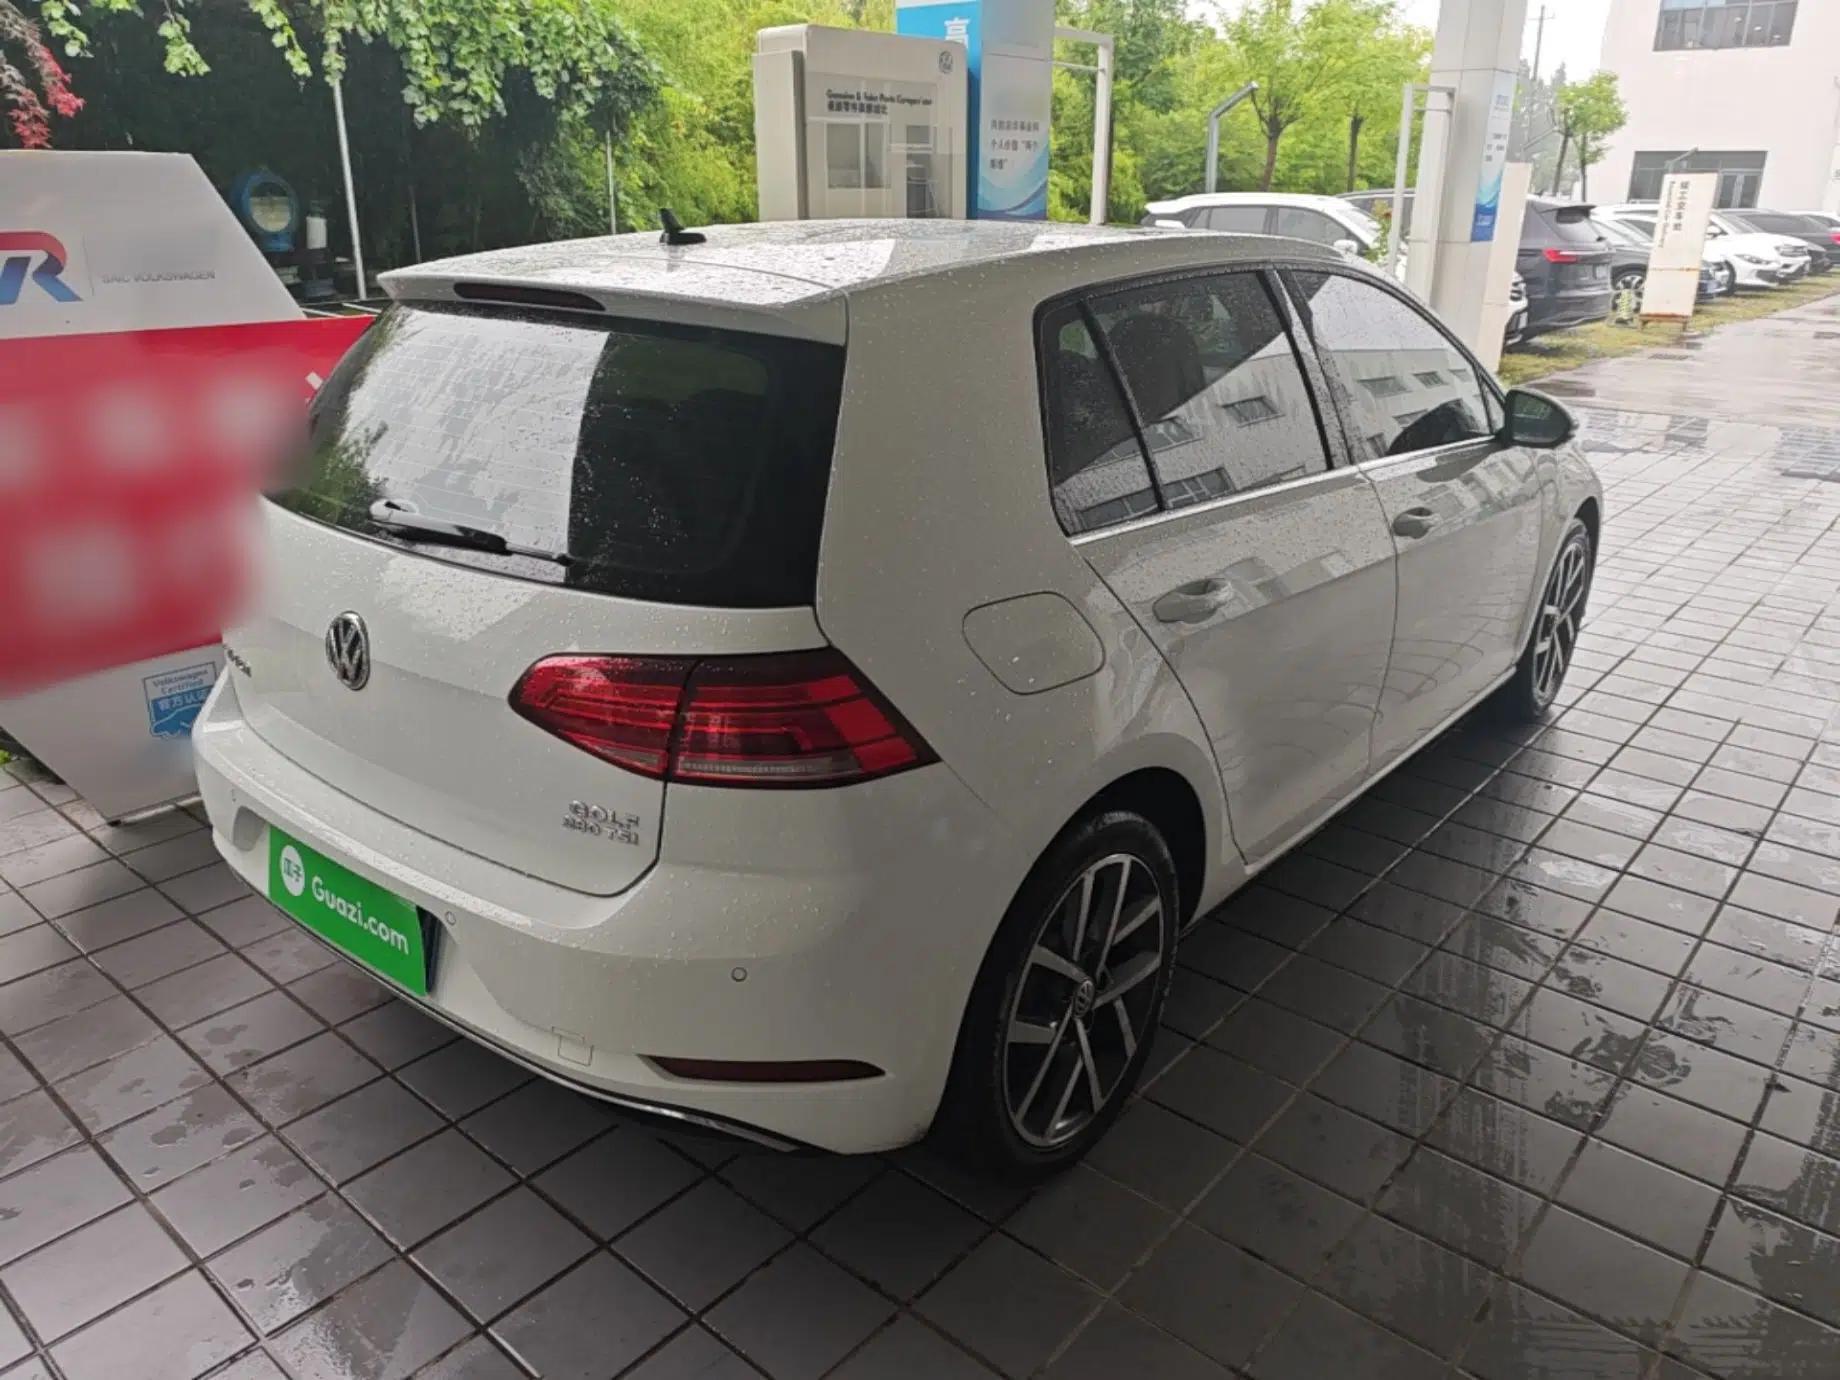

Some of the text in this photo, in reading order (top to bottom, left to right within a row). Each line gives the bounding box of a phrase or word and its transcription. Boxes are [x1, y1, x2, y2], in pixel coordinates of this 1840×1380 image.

[134, 269, 216, 282] VOLKSWAGEN
[152, 669, 208, 687] Volkswagen
[161, 678, 204, 694] Certified
[568, 800, 640, 829] GOLF
[602, 825, 639, 846] TSI
[311, 875, 409, 955] Guazi.com
